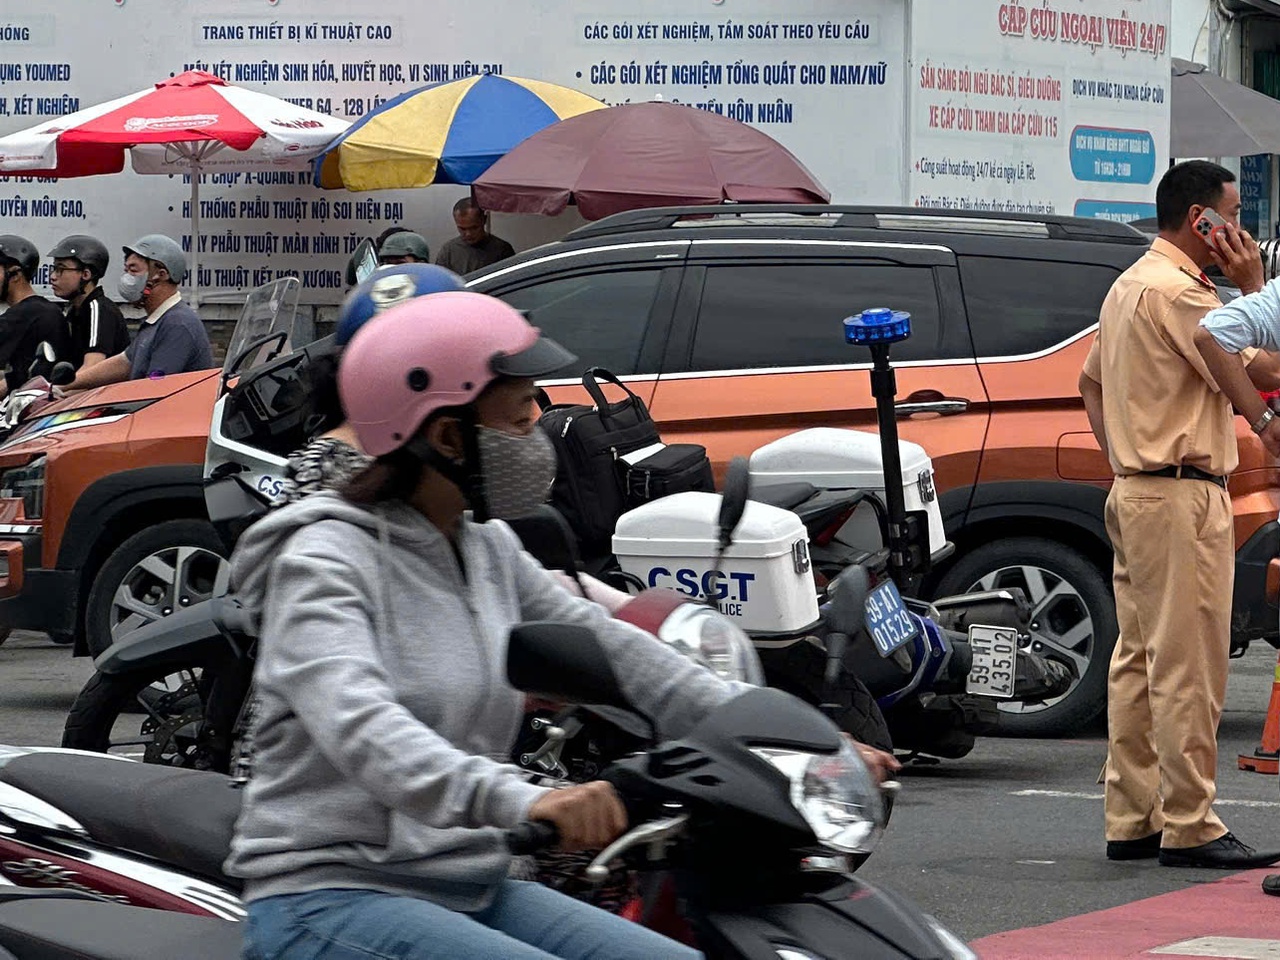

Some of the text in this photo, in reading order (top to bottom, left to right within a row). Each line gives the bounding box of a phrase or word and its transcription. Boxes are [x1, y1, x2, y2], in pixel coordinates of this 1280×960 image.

[203, 25, 244, 40] TRANG
[250, 21, 283, 40] THIẾT
[288, 26, 301, 42] BỊ
[321, 22, 362, 42] THUẬT
[367, 25, 392, 40] CAO
[584, 19, 870, 43] CÁC GÓI XÉT NGHIỆM, TẦM SOÁT THEO YÊU CẦU
[1061, 12, 1102, 53] NGOẠI
[1106, 9, 1137, 56] VIỆN
[1140, 22, 1166, 58] 24/7
[26, 64, 71, 82] YOUMED
[235, 60, 279, 86] NGHIỆM
[283, 63, 308, 82] SINH
[312, 60, 338, 84] HÓA,
[342, 59, 376, 82] HUYẾT
[380, 63, 405, 85] HỌC,
[409, 63, 420, 82] VI
[423, 63, 449, 82] SINH
[590, 59, 887, 89] CÁC GÓI XÉT NGHIỆM TỔNG QUÁT CHO NAM/NỮ
[13, 94, 34, 116] XÉT
[343, 98, 364, 116] 128
[758, 97, 793, 123] NHÂN
[929, 105, 938, 128] XE
[975, 109, 996, 133] THAM
[997, 111, 1010, 134] GIA
[1045, 116, 1057, 138] 115
[31, 195, 86, 220] MÔN CAO,
[200, 195, 404, 223] THỐNG PHẪU THUẬT NỘI SOI HIỆN ĐẠI
[211, 230, 339, 257] PHẪU THUẬT MÀN HÌNH
[215, 265, 249, 291] THUẬT
[303, 269, 341, 288] XƯƠNG
[873, 609, 914, 651] 015.29
[991, 631, 1014, 693] 435.02
